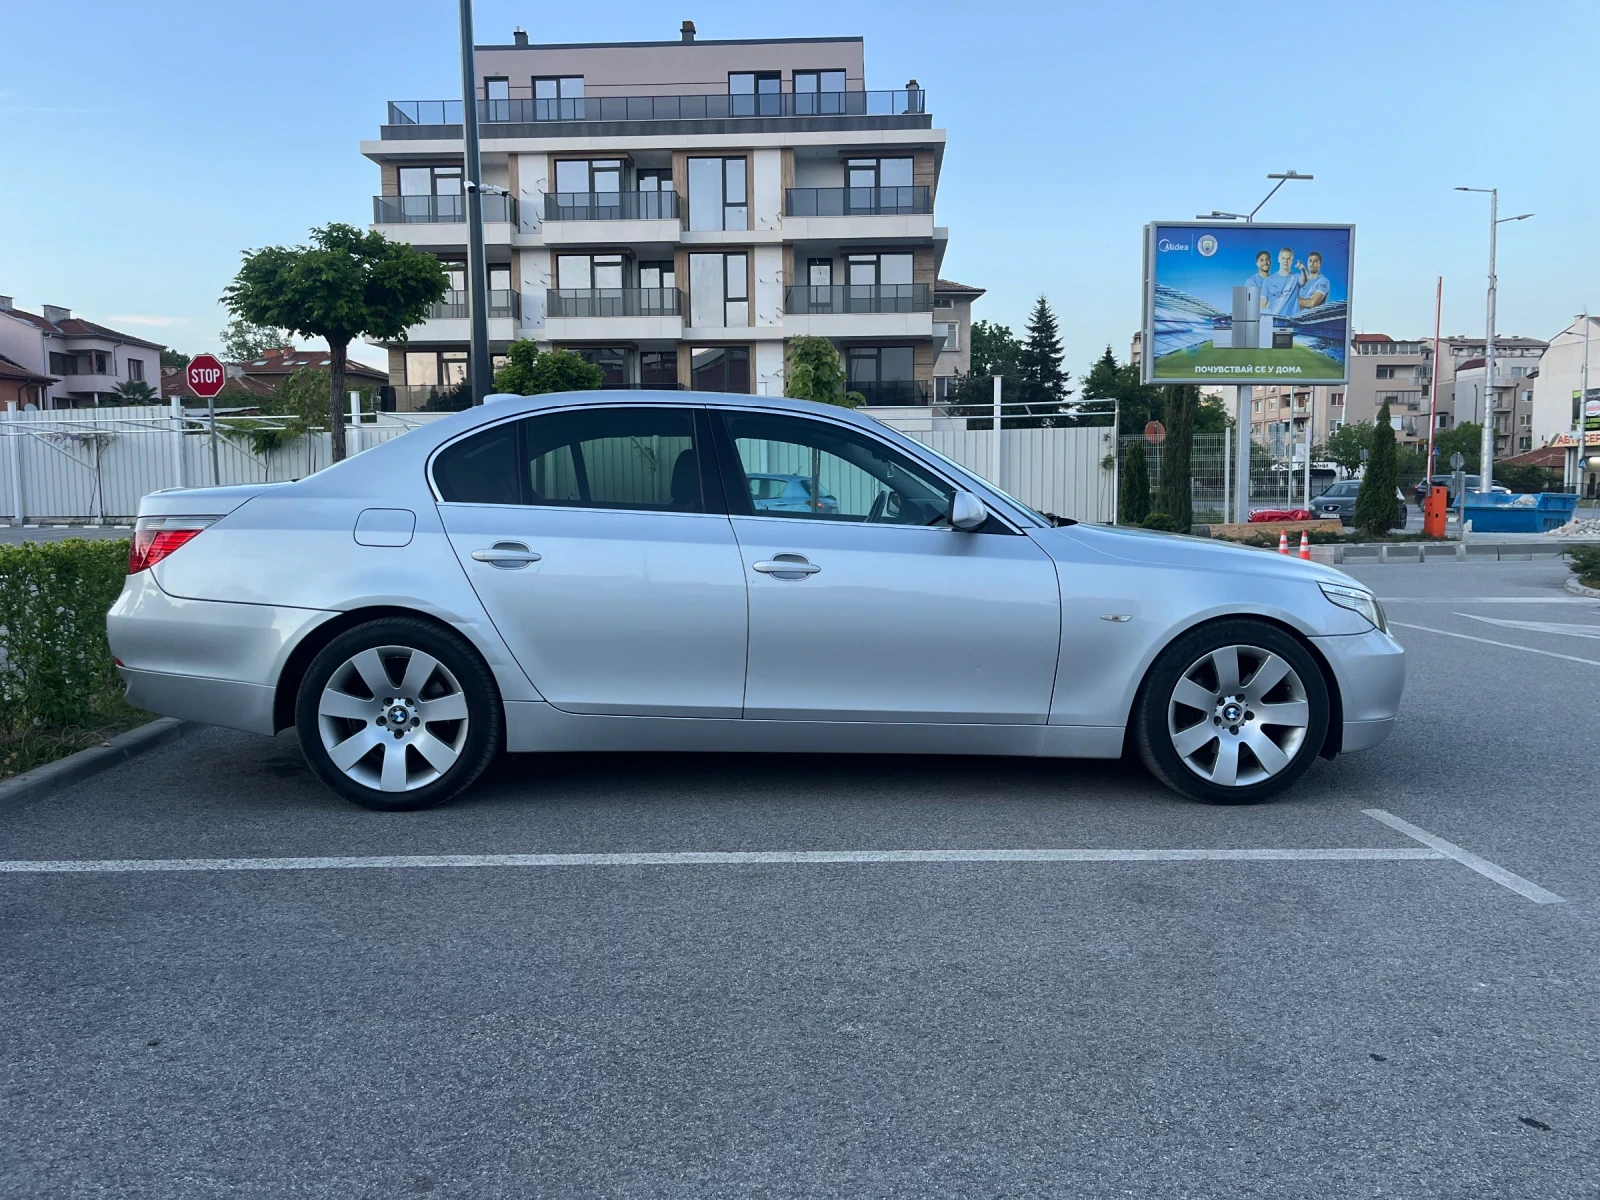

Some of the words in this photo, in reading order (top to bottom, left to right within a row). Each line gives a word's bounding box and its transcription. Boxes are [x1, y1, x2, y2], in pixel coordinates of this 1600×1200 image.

[1159, 241, 1188, 251] Midea
[1195, 364, 1252, 373] ПОЧУВСТВАЙ
[1276, 366, 1301, 374] ДОМА
[191, 368, 220, 383] STOP
